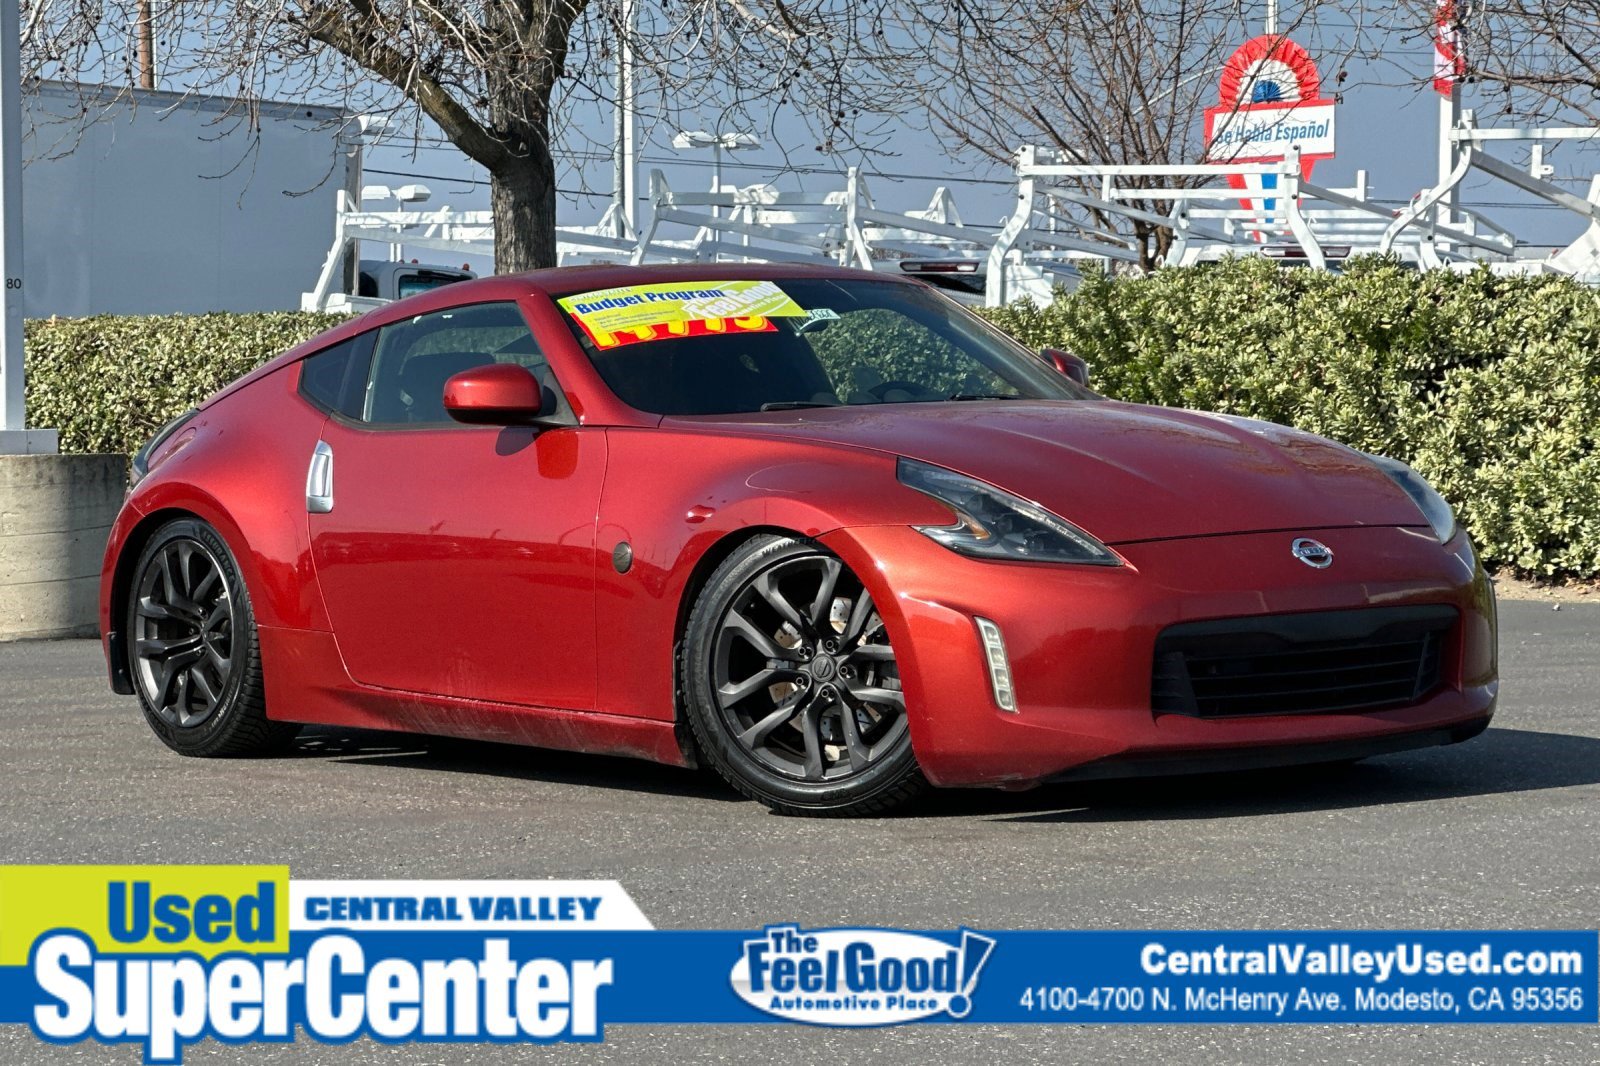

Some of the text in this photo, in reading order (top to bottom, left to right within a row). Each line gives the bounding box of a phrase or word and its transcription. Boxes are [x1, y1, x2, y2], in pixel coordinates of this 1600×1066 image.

[1235, 122, 1272, 143] Habla
[1275, 117, 1330, 144] Español
[6, 278, 22, 289] 80
[573, 294, 647, 315] Budget
[643, 289, 726, 303] Program
